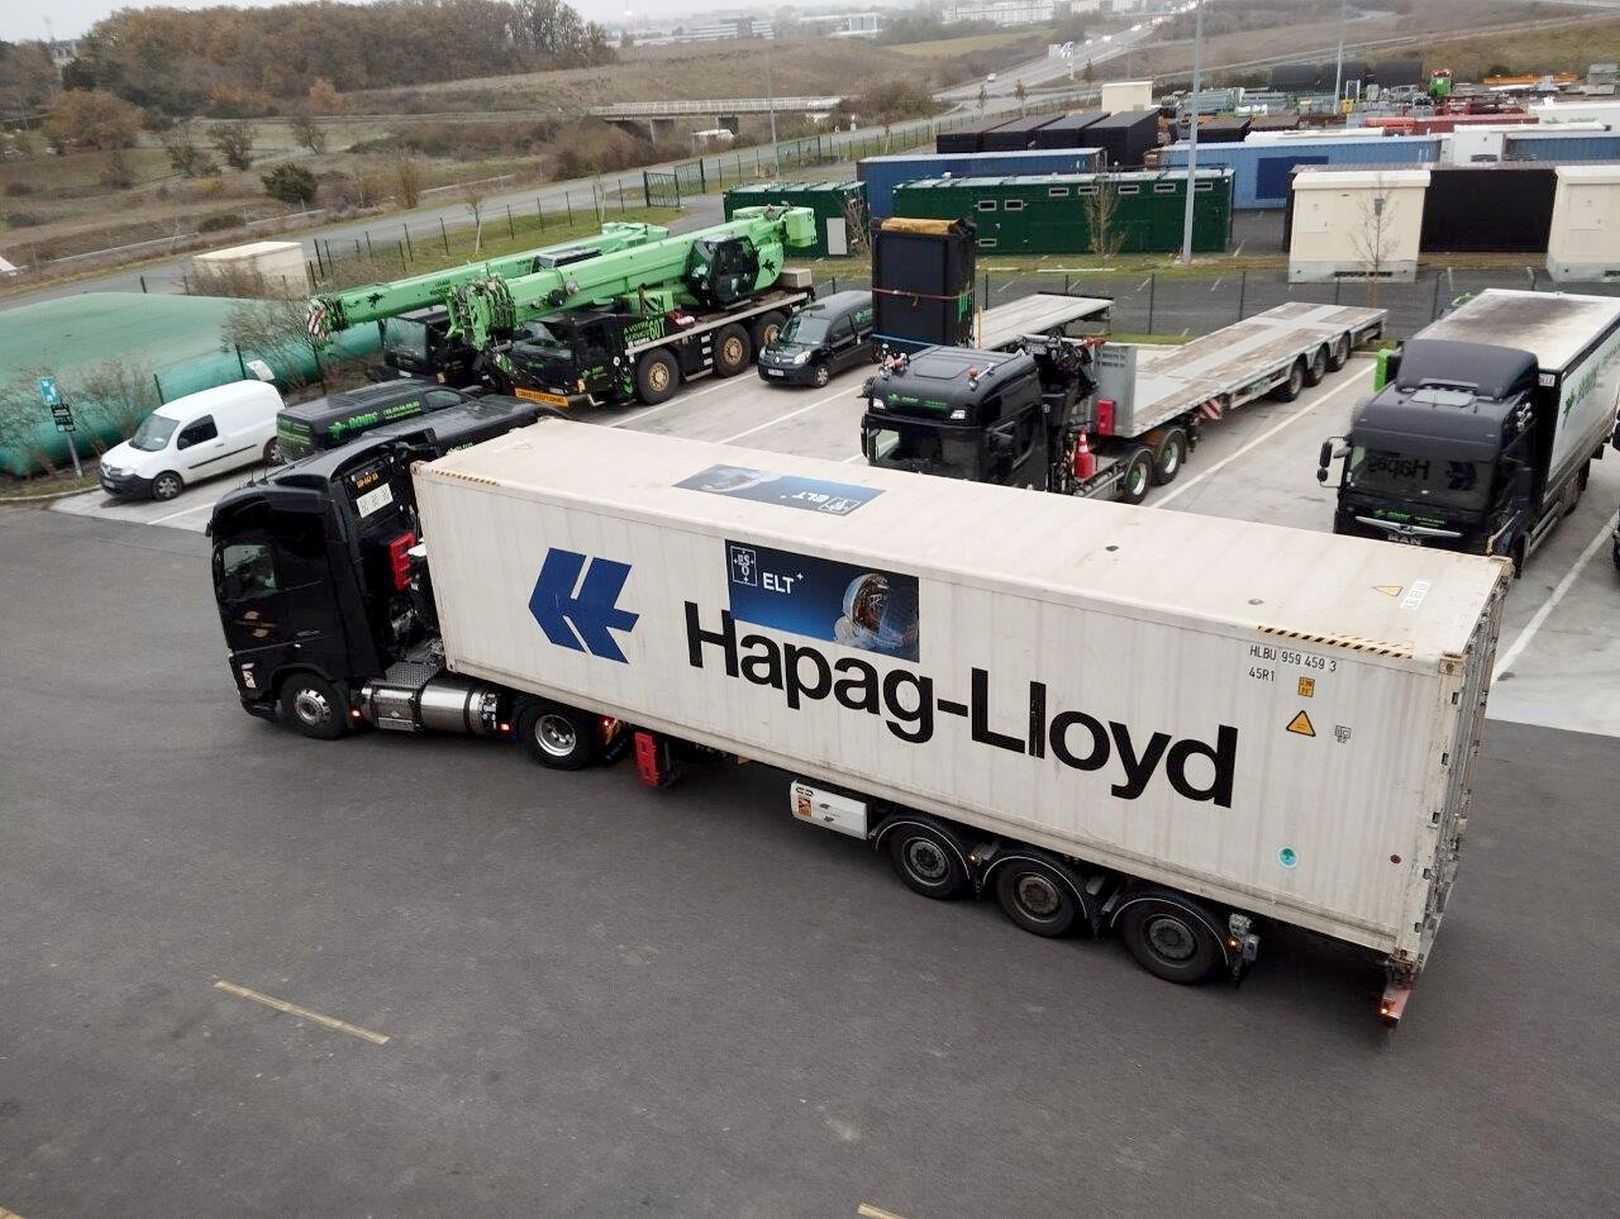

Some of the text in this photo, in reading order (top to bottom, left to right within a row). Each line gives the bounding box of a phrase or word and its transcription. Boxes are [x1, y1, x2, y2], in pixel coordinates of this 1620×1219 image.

[762, 571, 795, 594] ELT
[1250, 644, 1337, 672] HLBU 959 459 3
[1248, 666, 1275, 682] 45R1
[684, 601, 1239, 808] Hapag-Lloyd
